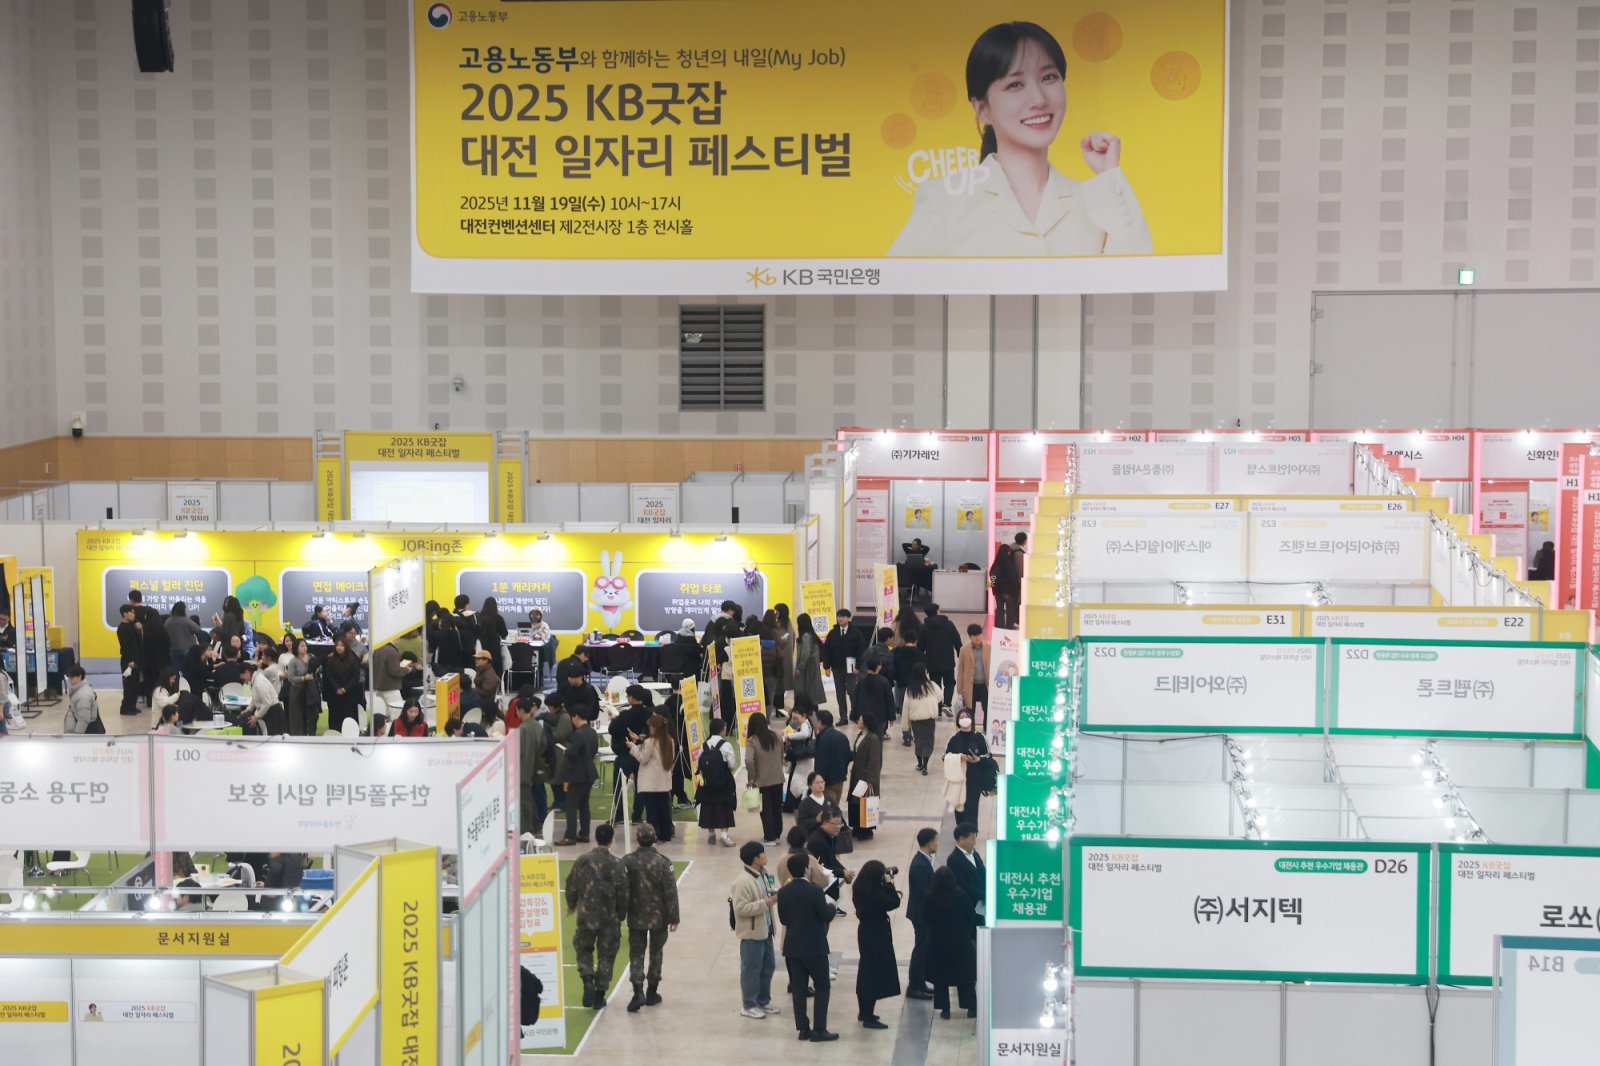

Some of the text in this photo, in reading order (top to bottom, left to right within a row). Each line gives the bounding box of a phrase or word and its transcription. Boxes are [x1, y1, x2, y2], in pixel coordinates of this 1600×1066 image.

[458, 10, 508, 23] 고용노동부
[459, 45, 846, 74] 고용노동부와 함께하는 청년의 내일(My Job)
[461, 81, 727, 125] 2025 KB굿잡
[461, 133, 851, 179] 대전 일자리 페스티벌
[907, 146, 979, 184] CHEER
[944, 166, 991, 195] UP
[460, 195, 682, 213] 2025년 11월 19일(수) 10시~17시
[460, 218, 694, 235] 대전컨벤션센터 제2전시장 1층 전시홀
[783, 267, 880, 286] KB 국민은행
[390, 437, 447, 447] 2025 KB굿잡
[378, 448, 460, 458] 대전 일자리 페스티벌
[1526, 449, 1558, 461] 신화인
[1215, 502, 1230, 510] E27
[1387, 503, 1403, 511] E26
[129, 579, 204, 592] 퍼스널 컬러 진단
[313, 581, 332, 592] 면접
[492, 582, 551, 593] 1분 캐리커처
[680, 582, 723, 595] 취업 타로
[1266, 615, 1286, 625] E31
[1504, 617, 1524, 627] E22
[1031, 661, 1056, 670] 대전시
[1022, 705, 1047, 715] 대전시
[1017, 747, 1045, 757] 대전시
[1009, 806, 1040, 817] 대전시
[1088, 853, 1109, 861] 2025
[1088, 862, 1162, 873] 대전 일자리 페스티벌
[1374, 859, 1408, 874] D26
[1458, 860, 1480, 868] 2025
[999, 872, 1061, 885] 대전시 추천
[1458, 870, 1536, 880] 대전 일자리 페스티벌
[1007, 887, 1053, 901] 우수기업
[1012, 902, 1048, 916] 채용관
[1193, 895, 1303, 925] (주)서지텍
[402, 900, 418, 953] 2025
[157, 931, 231, 947] 문서지원실
[401, 960, 419, 1028] KB굿잡
[997, 1042, 1061, 1057] 문서지원실
